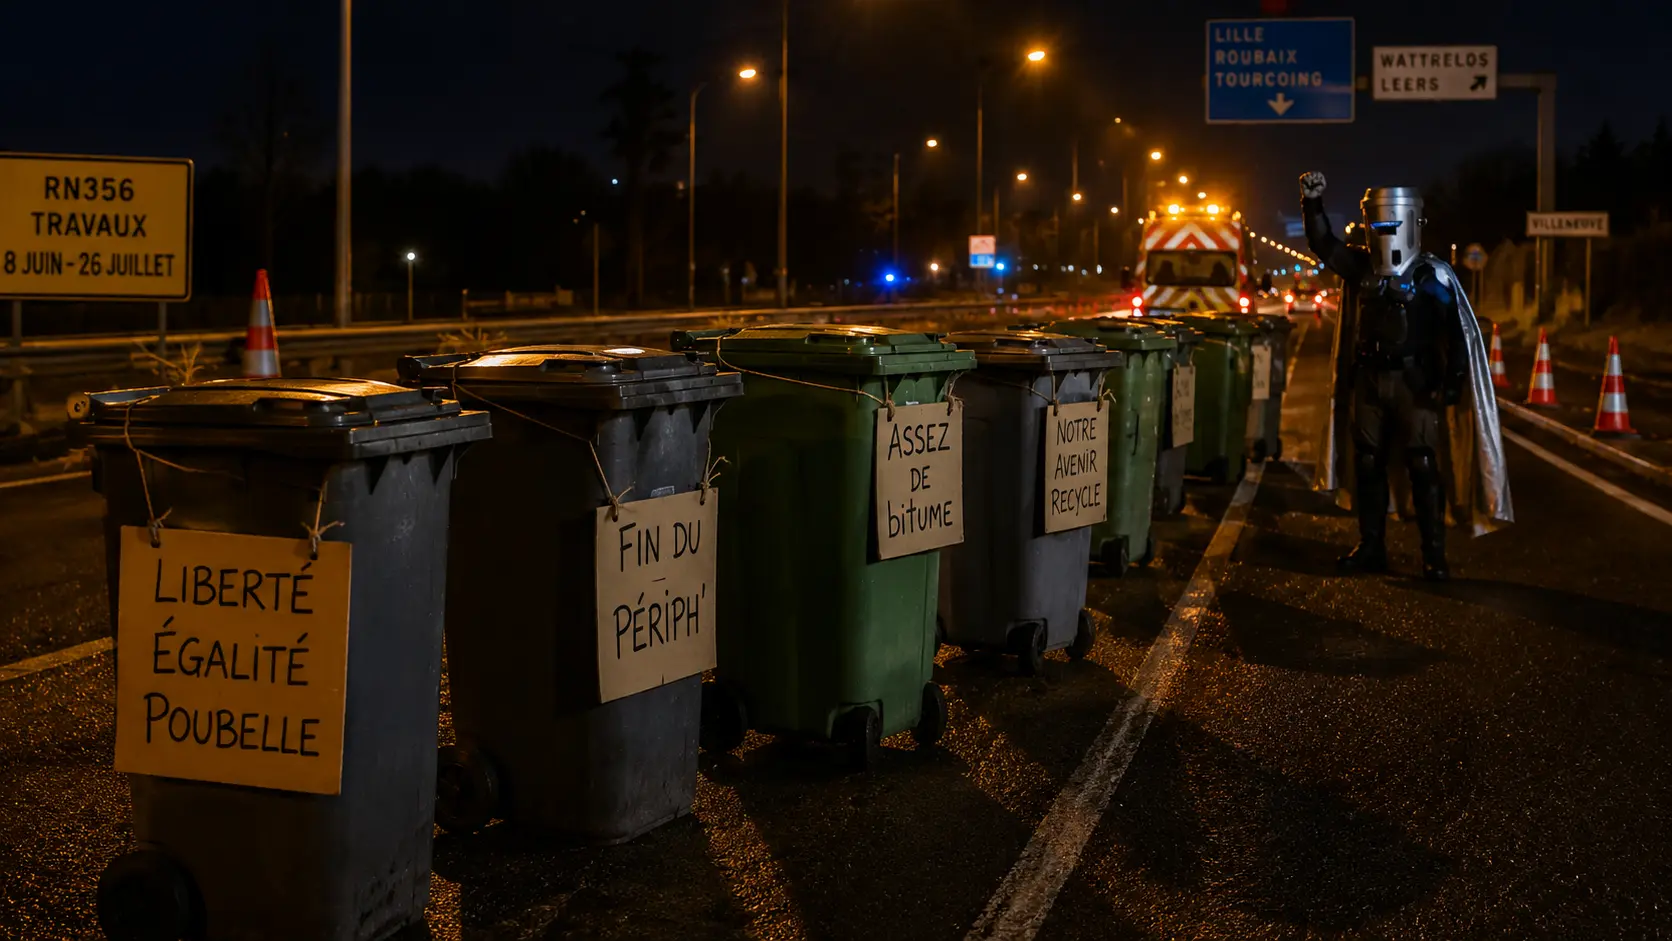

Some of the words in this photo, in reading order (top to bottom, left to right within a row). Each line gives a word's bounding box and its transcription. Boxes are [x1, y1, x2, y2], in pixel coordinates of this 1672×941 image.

[1215, 26, 1264, 43] LILLE
[1215, 49, 1298, 65] ROUBAIX
[1381, 52, 1489, 68] WATTRELOS
[1215, 71, 1323, 88] TOURCOING
[1381, 77, 1440, 92] LEERS
[44, 176, 134, 202] RN356
[31, 212, 147, 238] TRAVAUX
[1532, 217, 1604, 230] VILLENEUVE
[4, 250, 17, 275] 8
[22, 251, 62, 275] JUIN
[79, 252, 101, 276] 26
[106, 253, 175, 277] JUILLET
[888, 422, 950, 461] ASSEZ
[1056, 417, 1098, 446] NOTRE
[910, 465, 931, 493] DE
[1051, 483, 1101, 517] RECYCLE
[619, 522, 660, 573] FIN
[672, 519, 701, 559] DU
[155, 558, 314, 615] LIBERTÉ
[143, 692, 320, 757] POUBELLE
